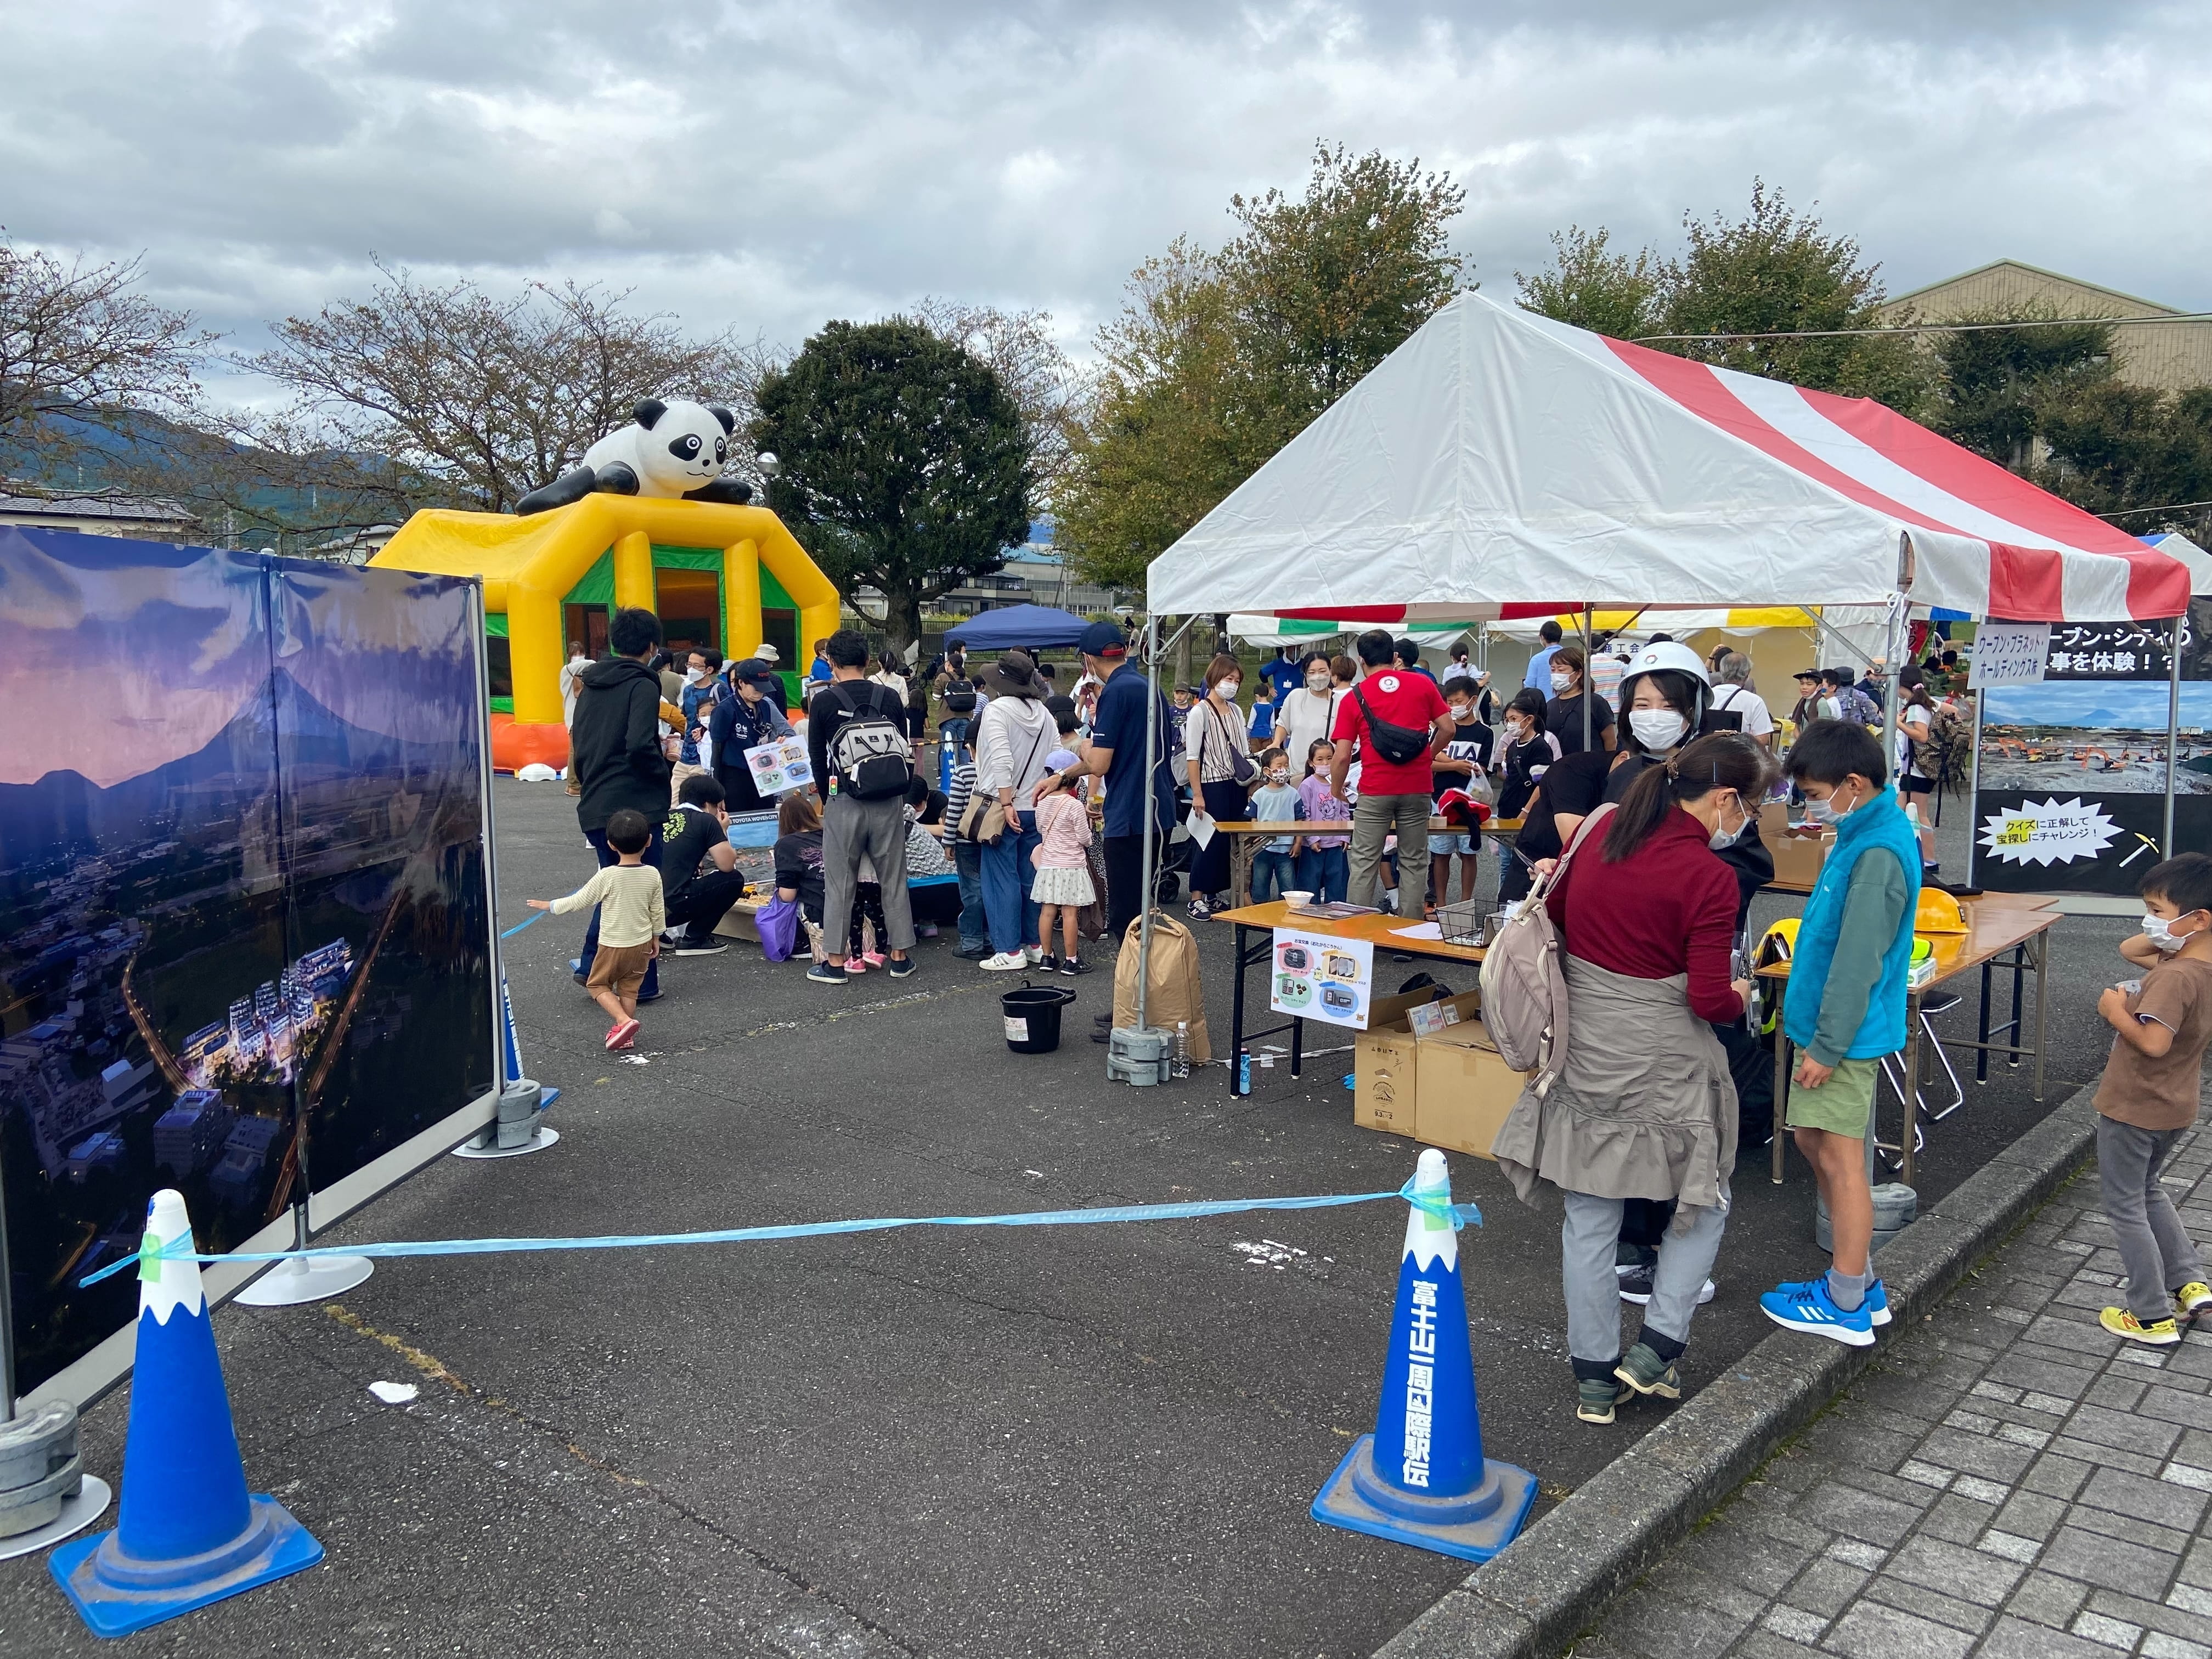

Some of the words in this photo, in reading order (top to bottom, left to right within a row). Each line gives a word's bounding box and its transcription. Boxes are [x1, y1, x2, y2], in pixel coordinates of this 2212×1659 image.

[1605, 643, 1650, 653] 商工会
[2006, 817, 2089, 831] クイズに正解して
[1997, 828, 2096, 844] 宝探しにチャレンジ！
[1403, 1280, 1438, 1487] 富士山一周国際駅伝
